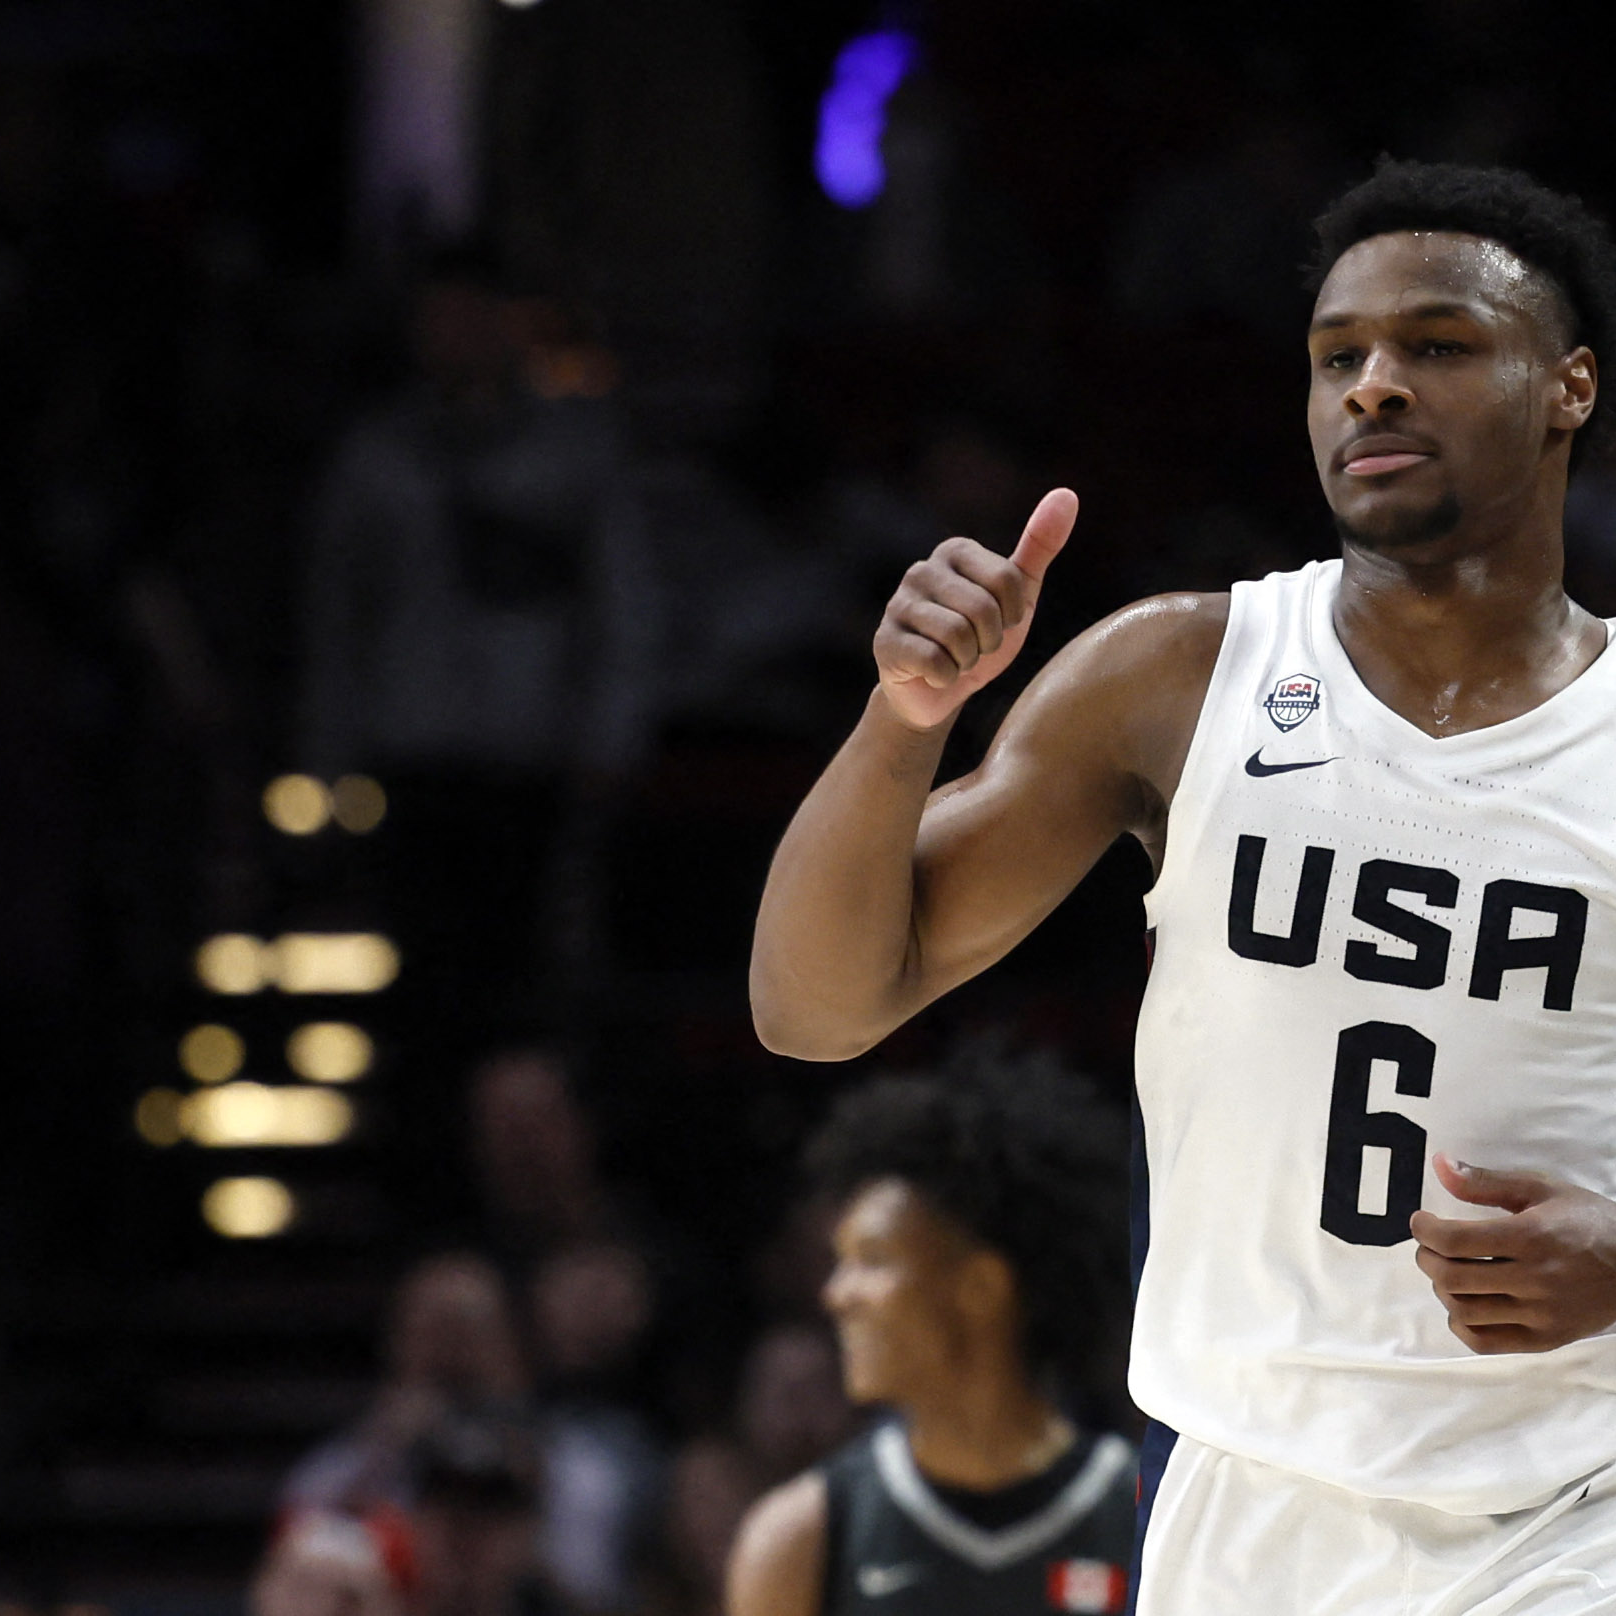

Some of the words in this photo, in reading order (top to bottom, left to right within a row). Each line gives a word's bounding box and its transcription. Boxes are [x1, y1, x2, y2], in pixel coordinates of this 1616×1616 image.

[1278, 683, 1312, 698] USA
[1227, 834, 1589, 1011] USA
[1320, 1021, 1436, 1247] 6
